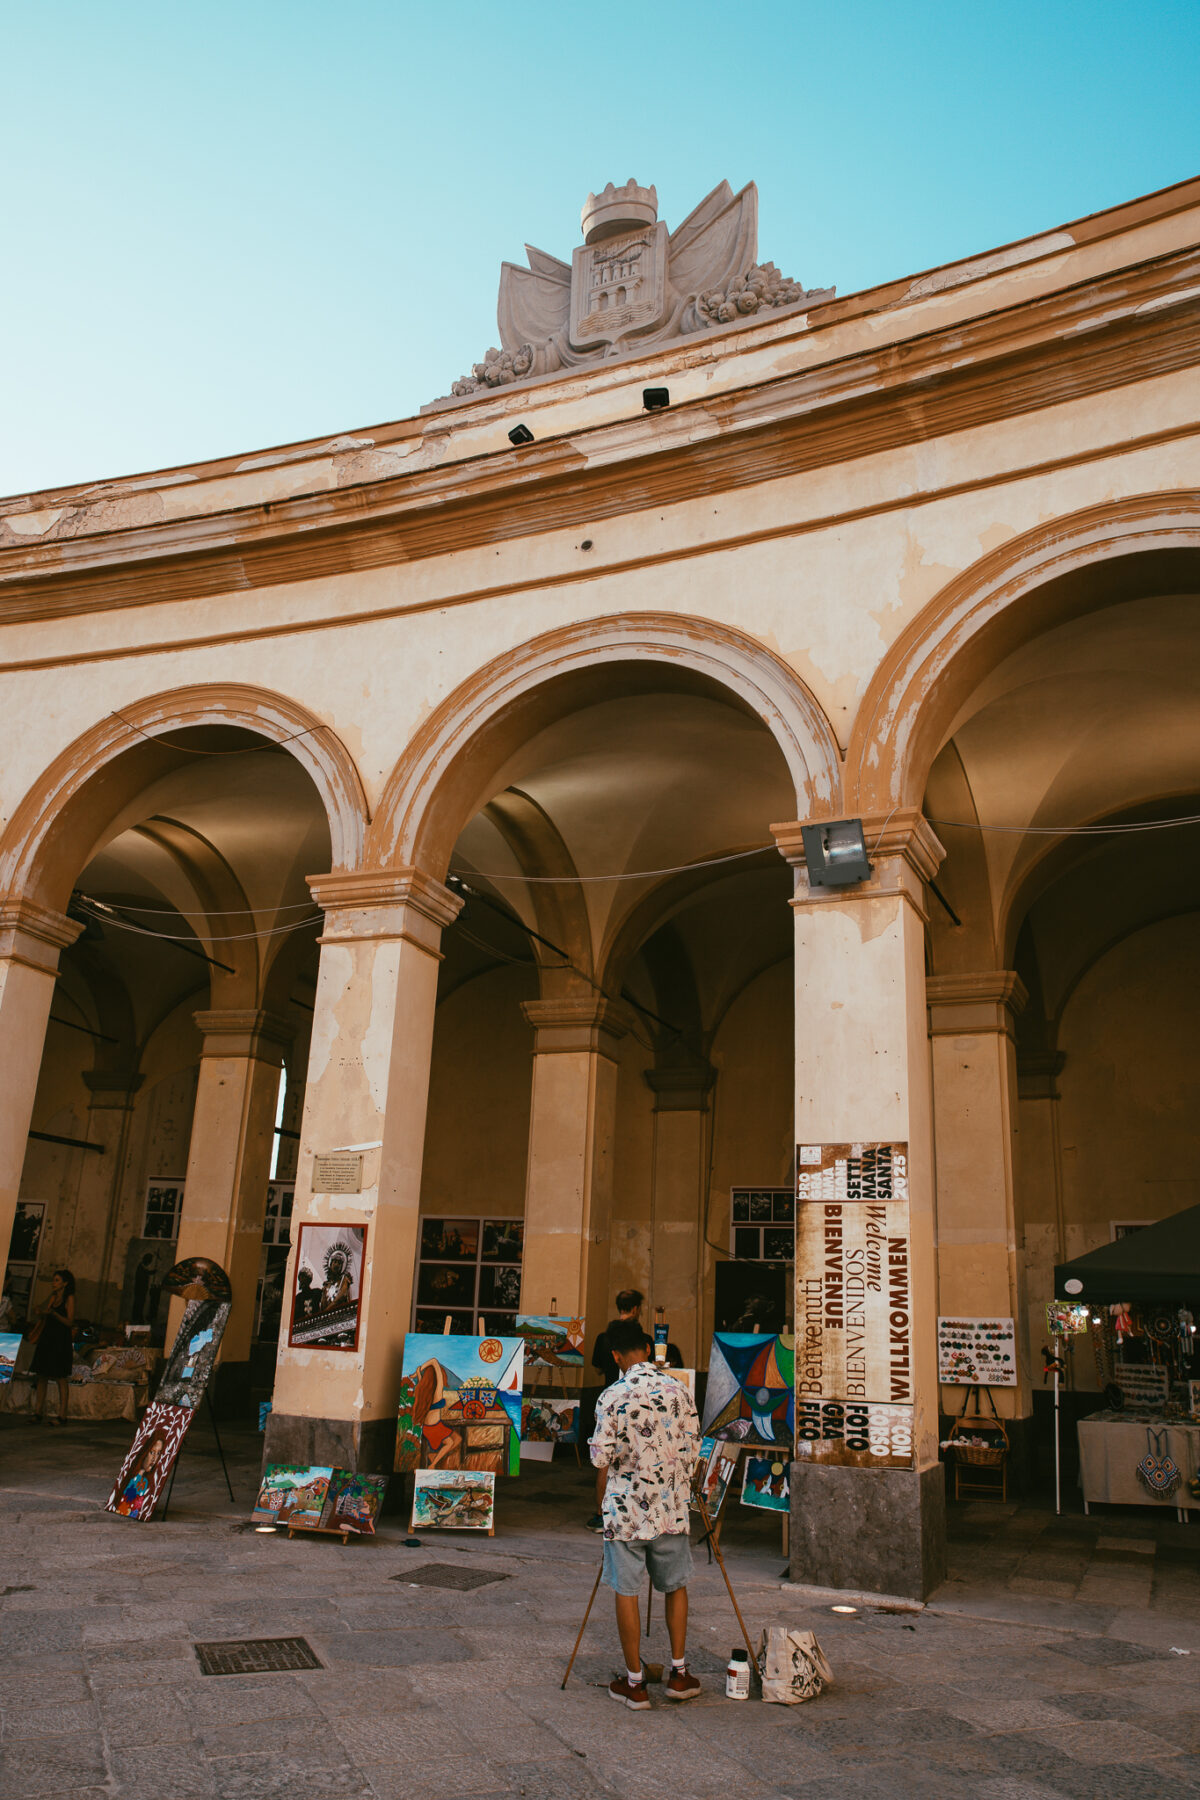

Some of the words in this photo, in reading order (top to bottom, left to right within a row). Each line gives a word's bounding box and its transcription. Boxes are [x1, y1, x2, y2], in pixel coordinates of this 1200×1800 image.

[799, 1172, 810, 1200] PRO
[810, 1172, 822, 1199] GRA
[822, 1166, 834, 1199] MMA
[835, 1159, 847, 1199] ZIONE
[847, 1158, 861, 1199] SETTI
[862, 1148, 876, 1199] MANA
[877, 1146, 892, 1199] SANTA
[893, 1155, 907, 1199] 2025
[824, 1204, 843, 1328] BIENVENUE
[866, 1205, 887, 1292] Welcome
[799, 1277, 823, 1395] Benvenuti
[846, 1249, 865, 1397] BIENVENIDOS
[888, 1238, 910, 1401] WILLKOMMEN
[799, 1402, 820, 1441] FICO
[822, 1404, 844, 1440] GRA
[846, 1405, 869, 1451] FOTO
[869, 1406, 890, 1457] CORSO
[891, 1425, 912, 1457] CON
